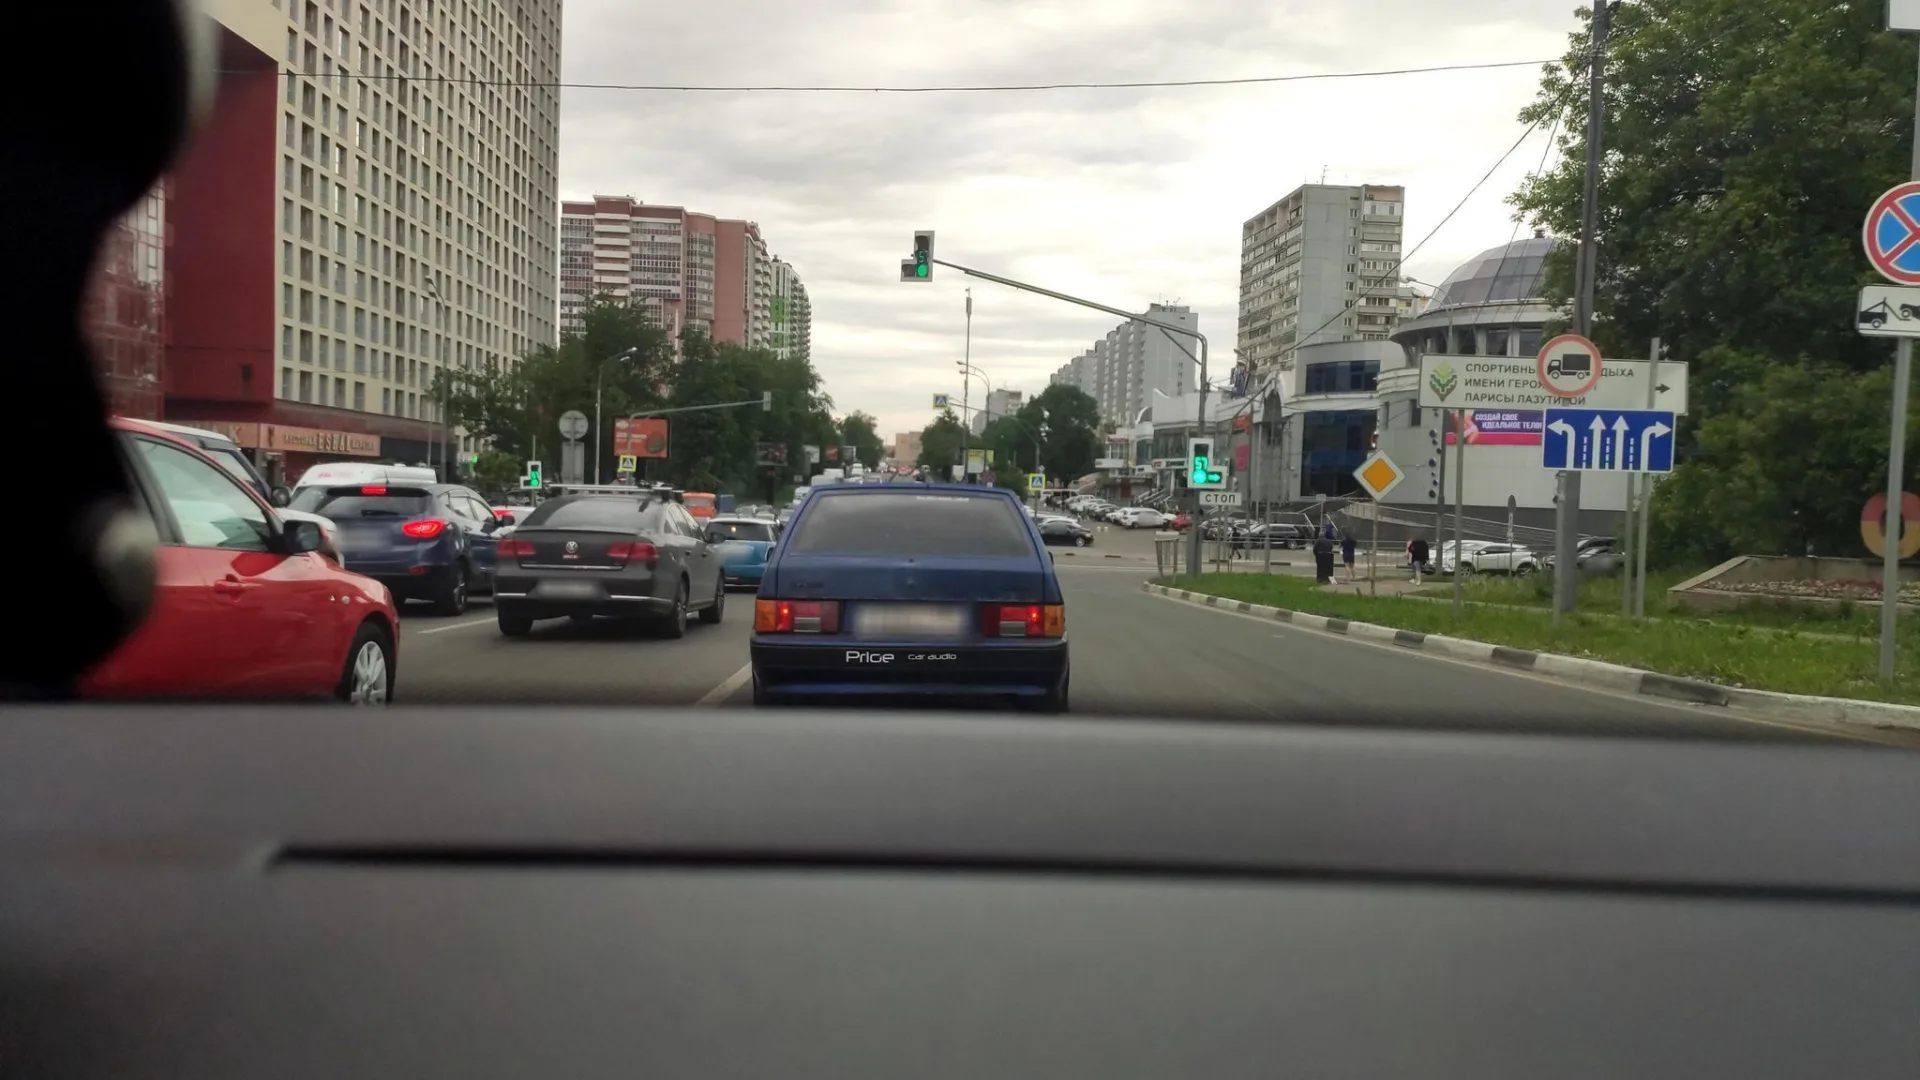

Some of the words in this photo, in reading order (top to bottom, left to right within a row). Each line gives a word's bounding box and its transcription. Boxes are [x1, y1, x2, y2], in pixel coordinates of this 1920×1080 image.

[1464, 378, 1505, 388] ИМЕНИ
[1465, 392, 1515, 403] ЛАРИСЫ
[1517, 394, 1586, 406] ЛАЗУТИОЙ
[1475, 413, 1501, 421] СОЗДАЙ
[1502, 413, 1519, 421] СВОЕ
[1482, 421, 1521, 430] ИДЕАЛЬНОЕ
[1205, 493, 1236, 503] СТОП
[927, 652, 957, 660] audio
